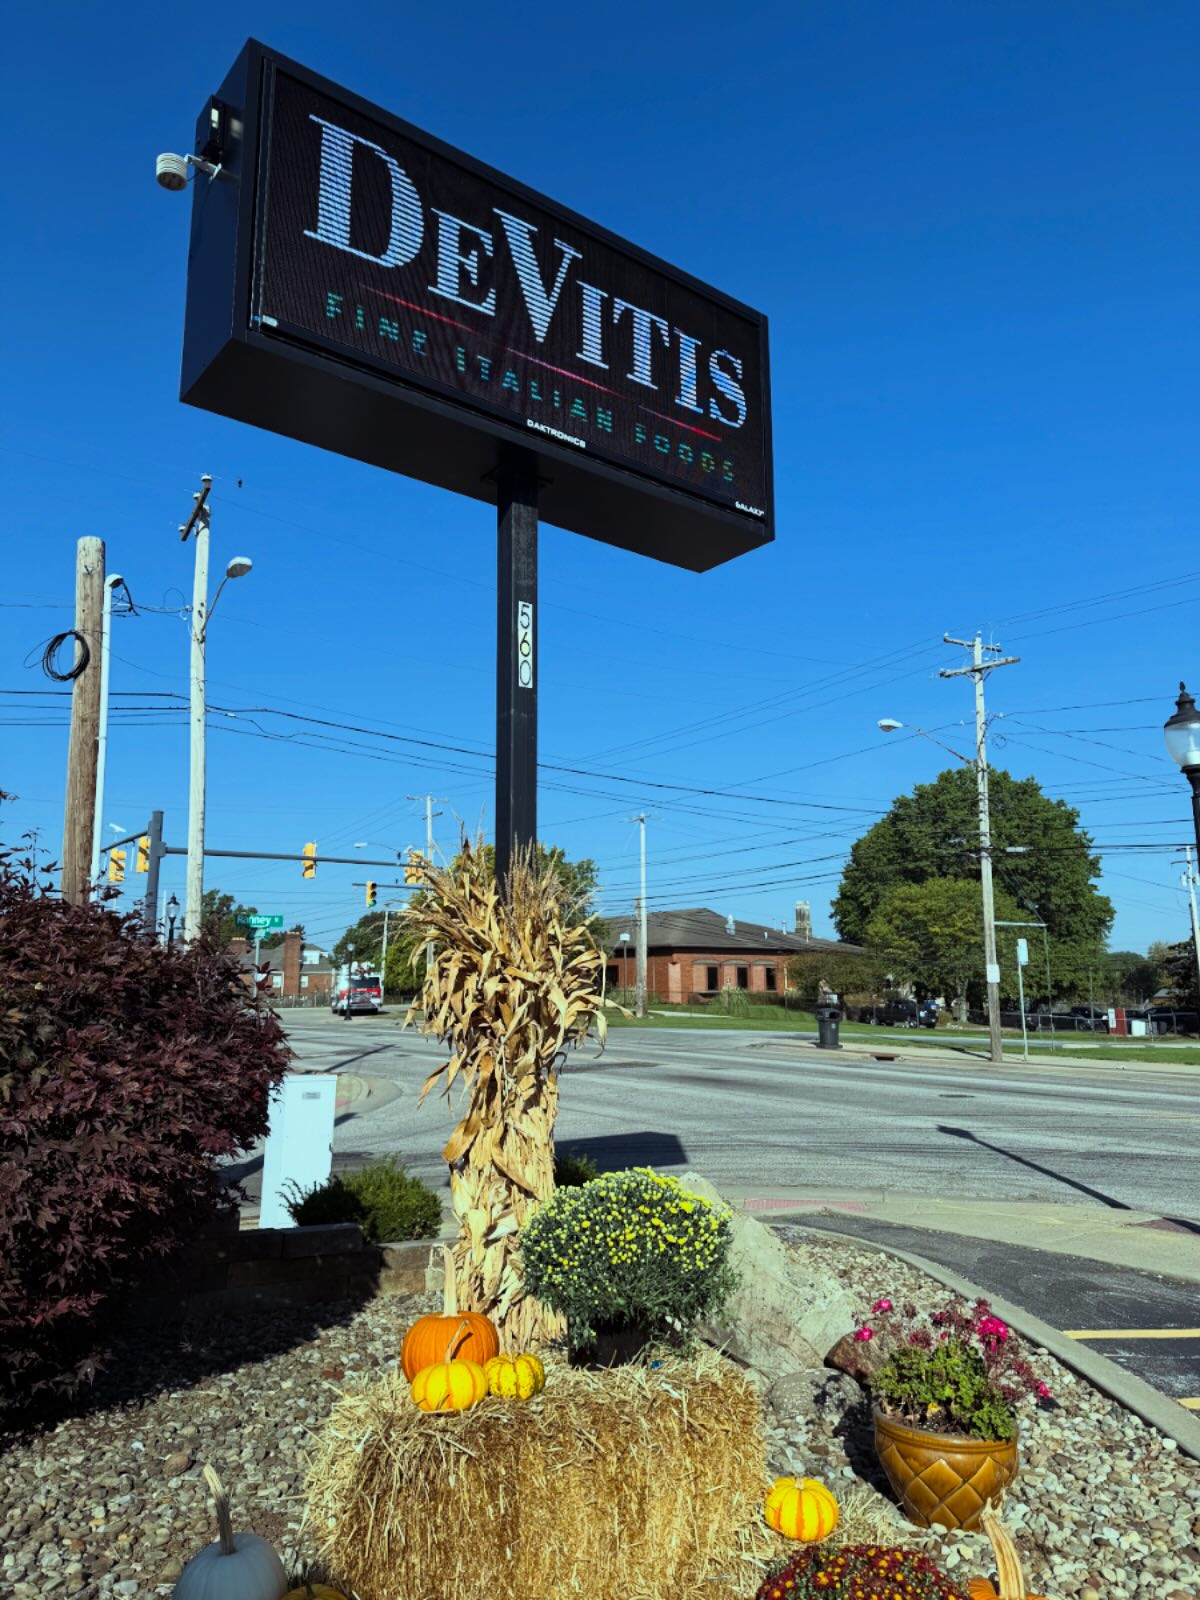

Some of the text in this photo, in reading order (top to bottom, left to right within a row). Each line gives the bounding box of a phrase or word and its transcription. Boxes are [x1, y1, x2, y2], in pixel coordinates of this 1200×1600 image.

[326, 292, 734, 481] FINE ITALIAN FOODS
[519, 603, 531, 686] 560
